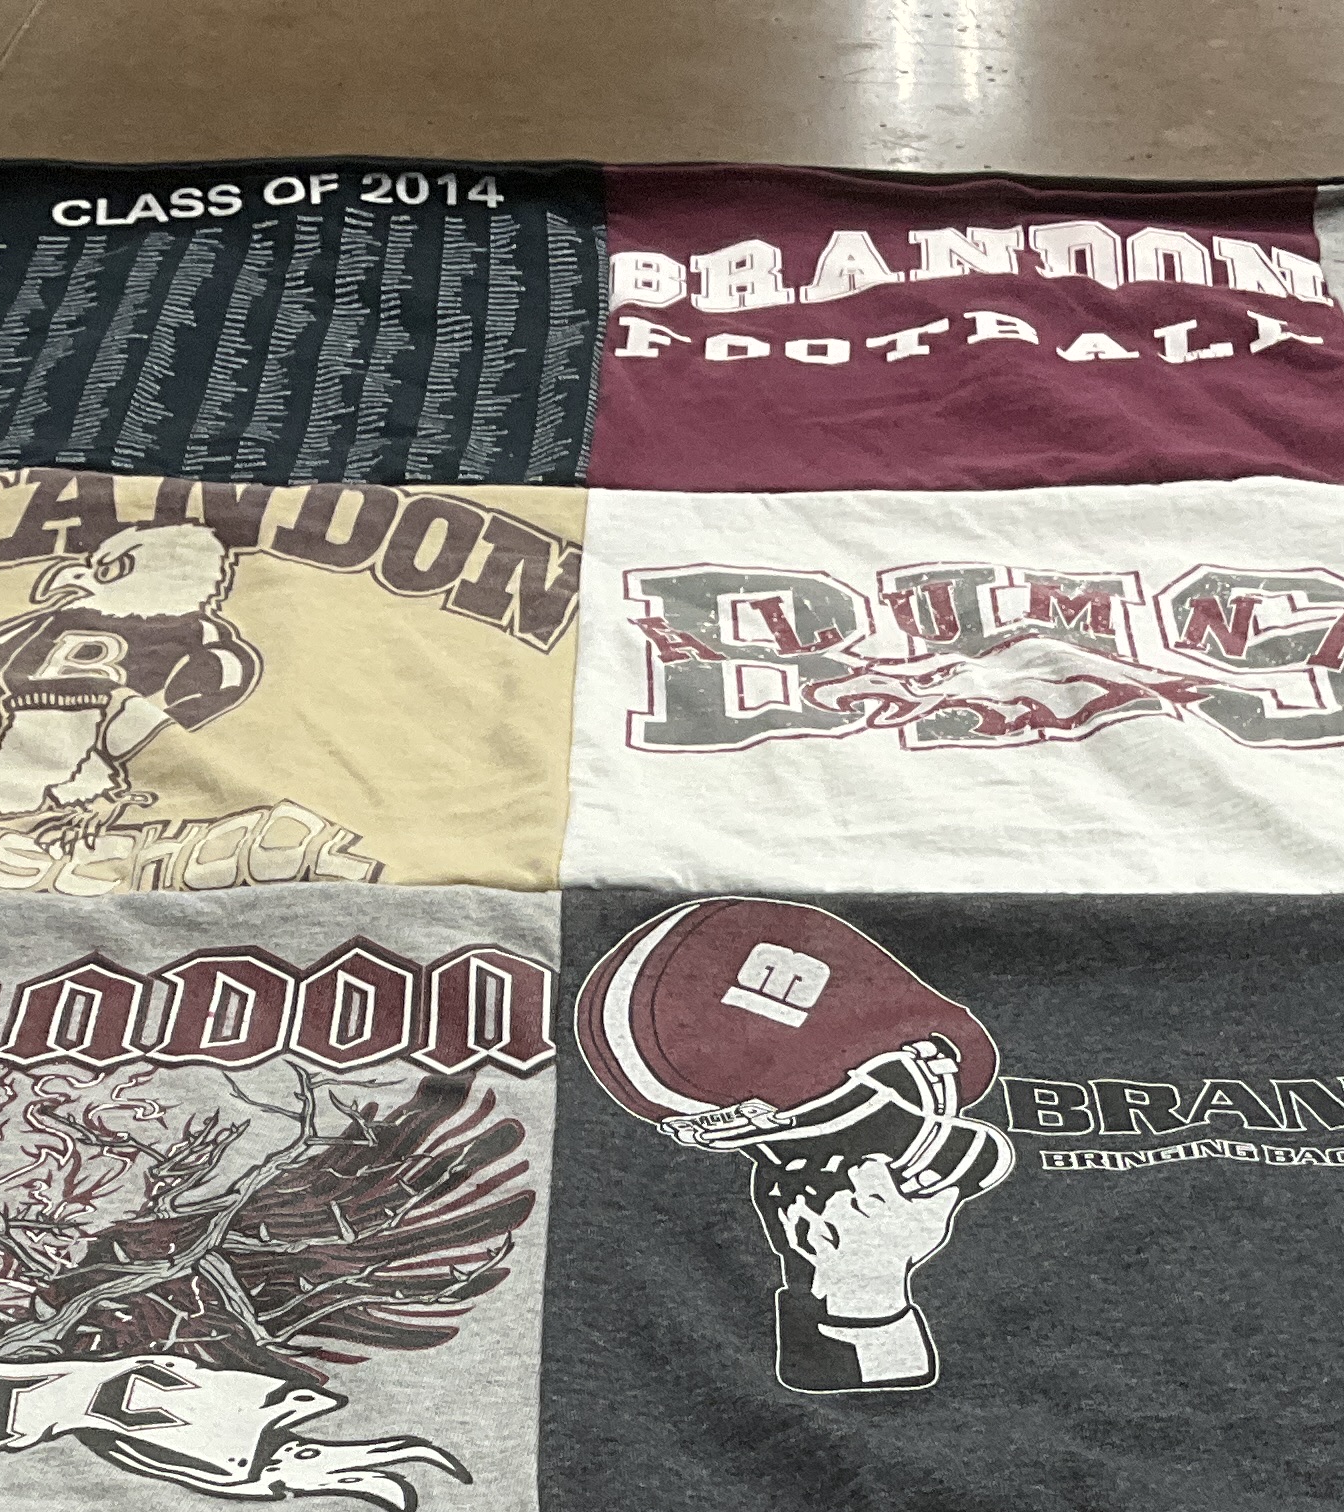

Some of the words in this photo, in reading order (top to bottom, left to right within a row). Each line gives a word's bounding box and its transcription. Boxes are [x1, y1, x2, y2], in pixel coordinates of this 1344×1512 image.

[52, 184, 244, 229] CLASS
[262, 173, 341, 207] OF
[360, 171, 504, 209] 2014
[609, 221, 1334, 313] BRANDON
[32, 631, 128, 682] B
[1039, 1139, 1260, 1171] BRINGING
